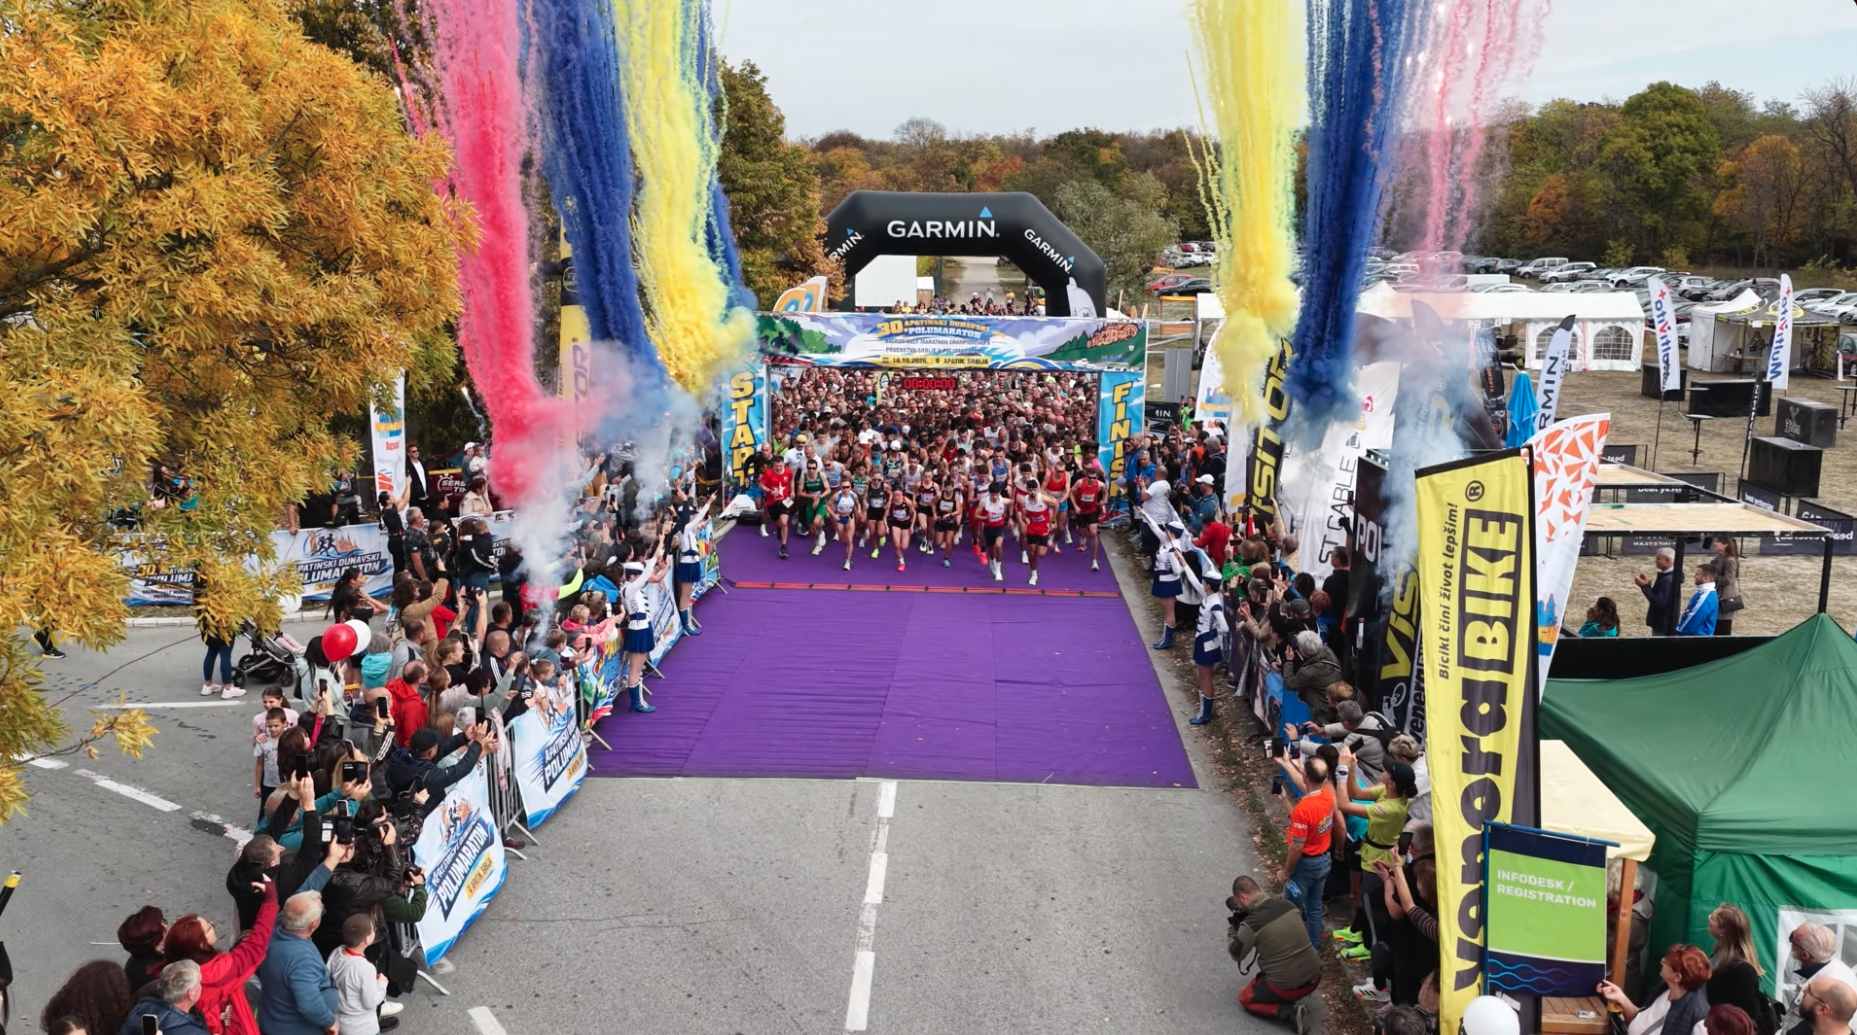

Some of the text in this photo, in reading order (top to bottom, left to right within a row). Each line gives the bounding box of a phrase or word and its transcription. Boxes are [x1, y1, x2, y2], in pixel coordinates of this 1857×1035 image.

[887, 220, 996, 238] GARMIN
[829, 229, 864, 262] RMIN
[1024, 229, 1074, 274] GARMIN
[908, 327, 982, 339] POLUMARATON
[1539, 356, 1559, 430] RMIN
[297, 553, 380, 573] PATINSKI DUNAVSKI
[1438, 502, 1458, 679] Bicikl čini život lepšim!
[437, 822, 489, 911] POLUMARATON
[1497, 869, 1564, 891] INFODESK
[1497, 884, 1596, 908] REGISTRATION
